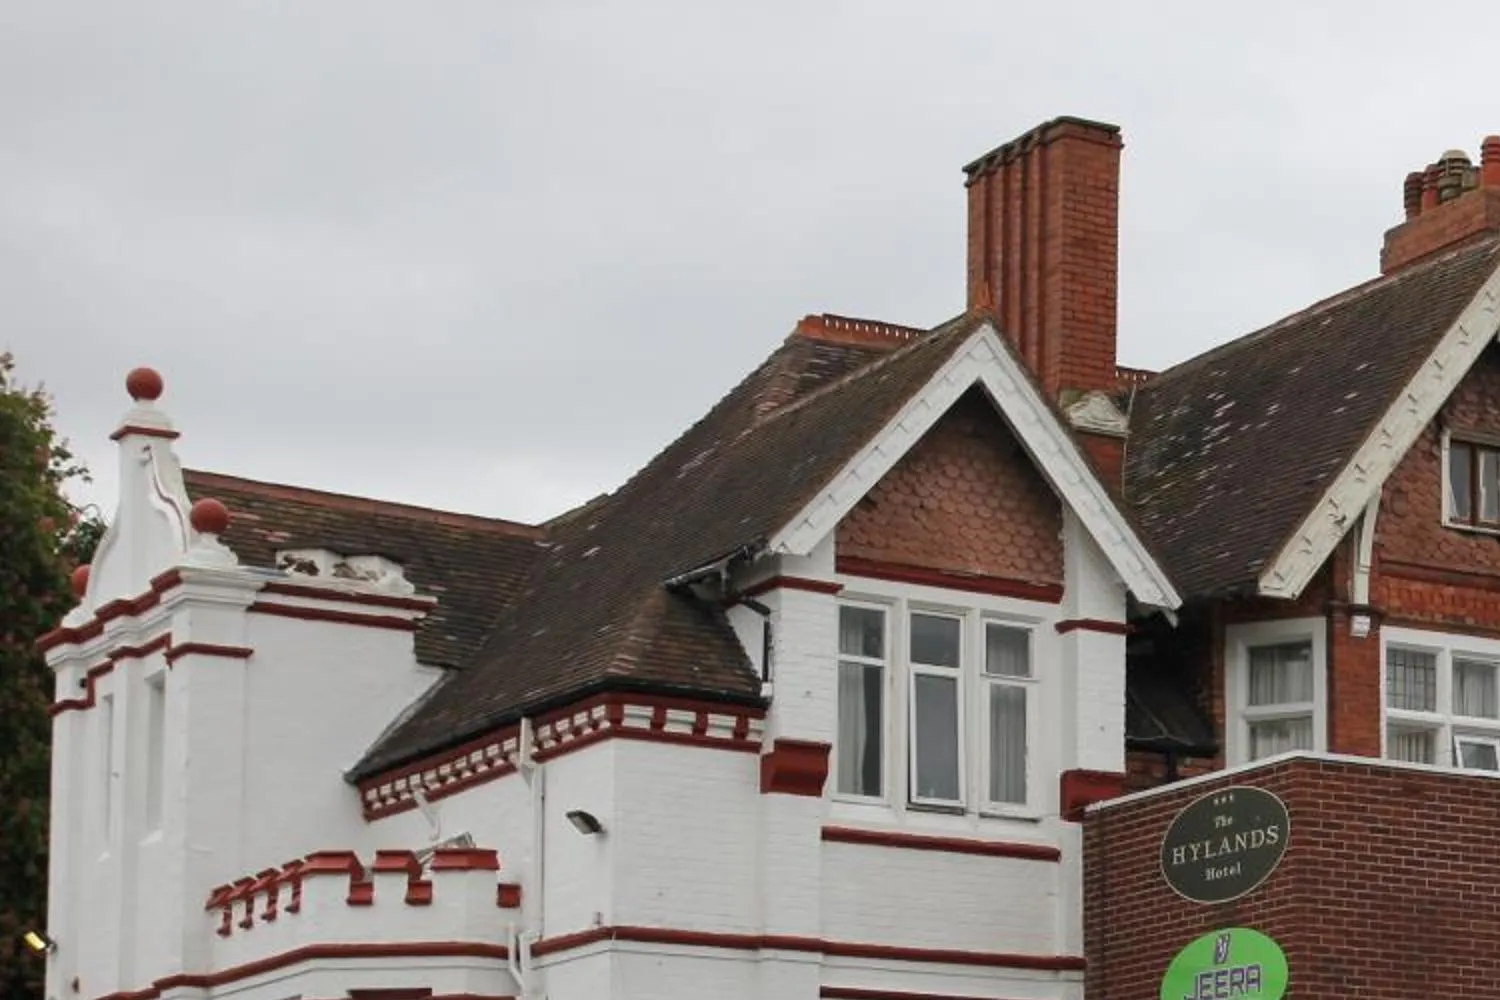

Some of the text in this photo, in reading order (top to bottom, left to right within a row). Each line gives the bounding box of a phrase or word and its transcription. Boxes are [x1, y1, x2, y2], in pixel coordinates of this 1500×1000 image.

[1214, 814, 1233, 829] The
[1172, 825, 1280, 865] HYLANDS
[1205, 861, 1241, 881] Hotel
